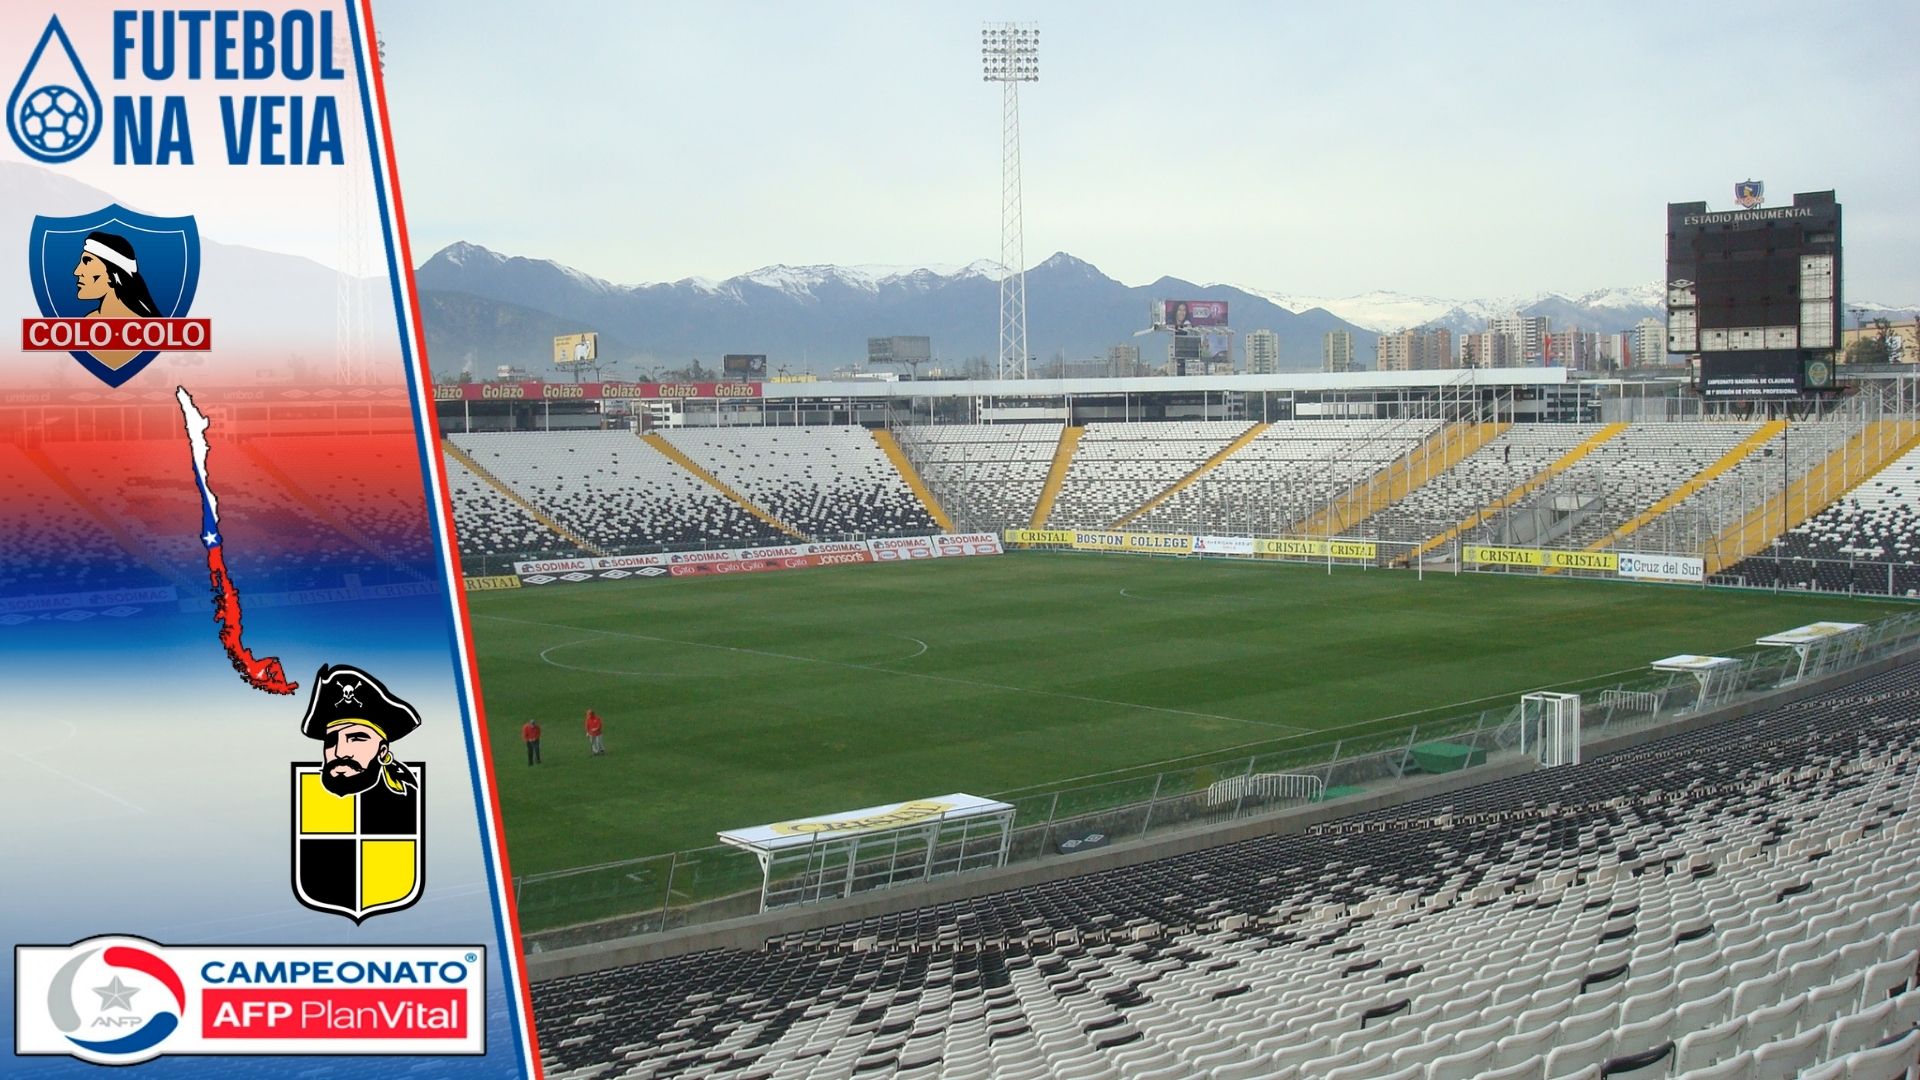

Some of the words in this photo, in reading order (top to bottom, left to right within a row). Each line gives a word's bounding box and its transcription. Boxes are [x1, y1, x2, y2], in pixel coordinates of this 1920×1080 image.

[1684, 213, 1731, 225] ESTADIO
[1734, 208, 1813, 221] MONUMENTAL
[482, 384, 524, 398] Golazo
[543, 384, 584, 398] Golazo
[602, 384, 641, 397] Golazo
[659, 384, 698, 397] Golazo
[715, 383, 753, 397] Golazo
[884, 539, 926, 548] SODIMAC
[949, 535, 993, 544] SODIMAC
[1021, 532, 1067, 542] CRISTAL
[1076, 533, 1124, 545] BOSTON
[1130, 536, 1188, 548] COLLEGE
[753, 547, 797, 558] SODIMAC
[819, 543, 861, 553] SODIMAC
[1267, 541, 1315, 553] CRISTAL
[1331, 544, 1374, 557] CRISTAL
[612, 556, 659, 567] SODIMAC
[683, 551, 729, 562] SODIMAC
[1480, 549, 1532, 563] CRISTAL
[1556, 553, 1610, 568] CRISTAL
[535, 561, 585, 572] SODIMAC
[1633, 560, 1659, 573] Cruz
[1663, 561, 1678, 575] del
[1681, 563, 1702, 577] Sur
[465, 577, 519, 589] RISTAL
[106, 590, 169, 603] SODIMAC
